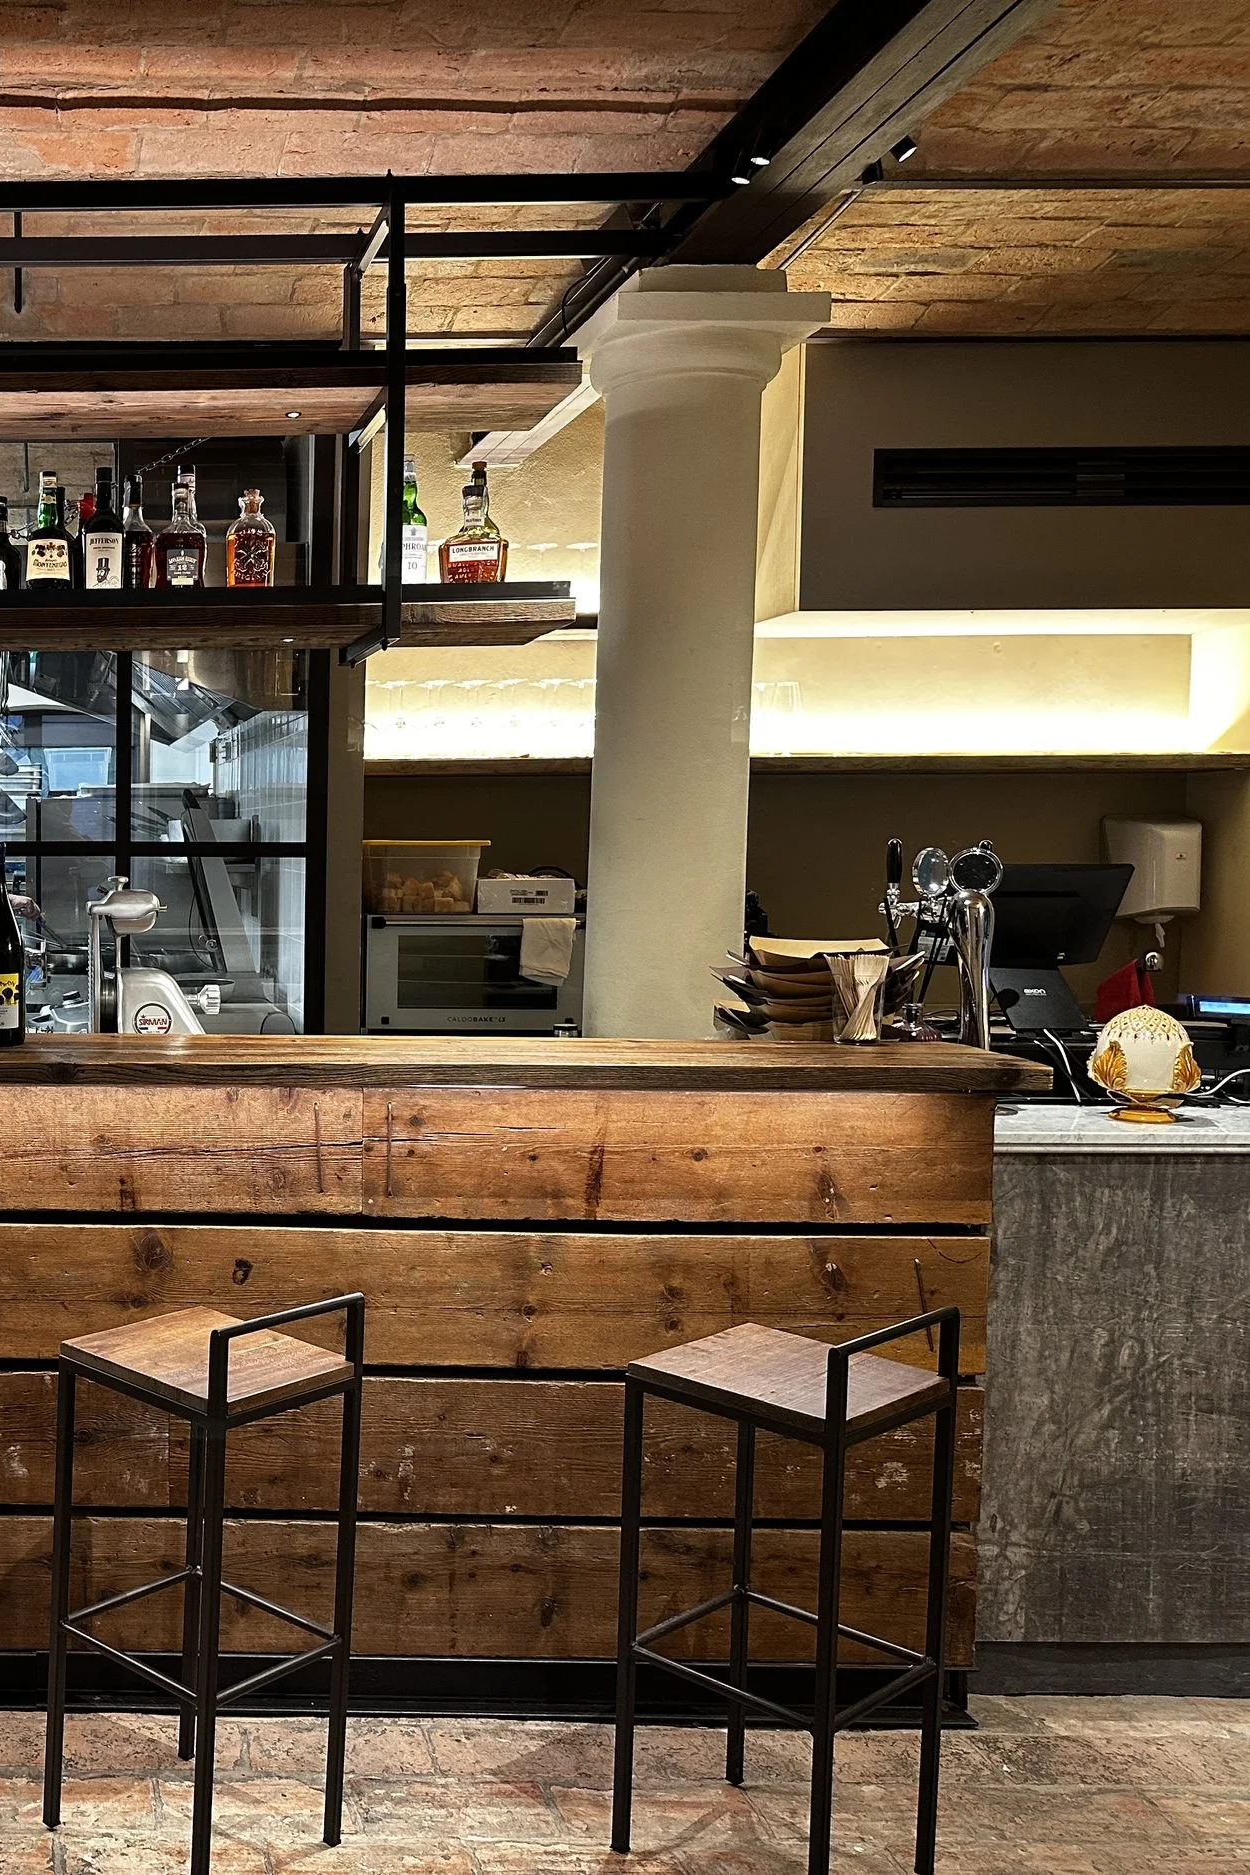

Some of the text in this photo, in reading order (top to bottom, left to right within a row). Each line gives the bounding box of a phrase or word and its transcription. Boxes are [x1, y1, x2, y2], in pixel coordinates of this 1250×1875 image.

[452, 545, 495, 554] LONGBRANCH
[407, 561, 418, 570] 10
[139, 1017, 168, 1026] SIRMAN
